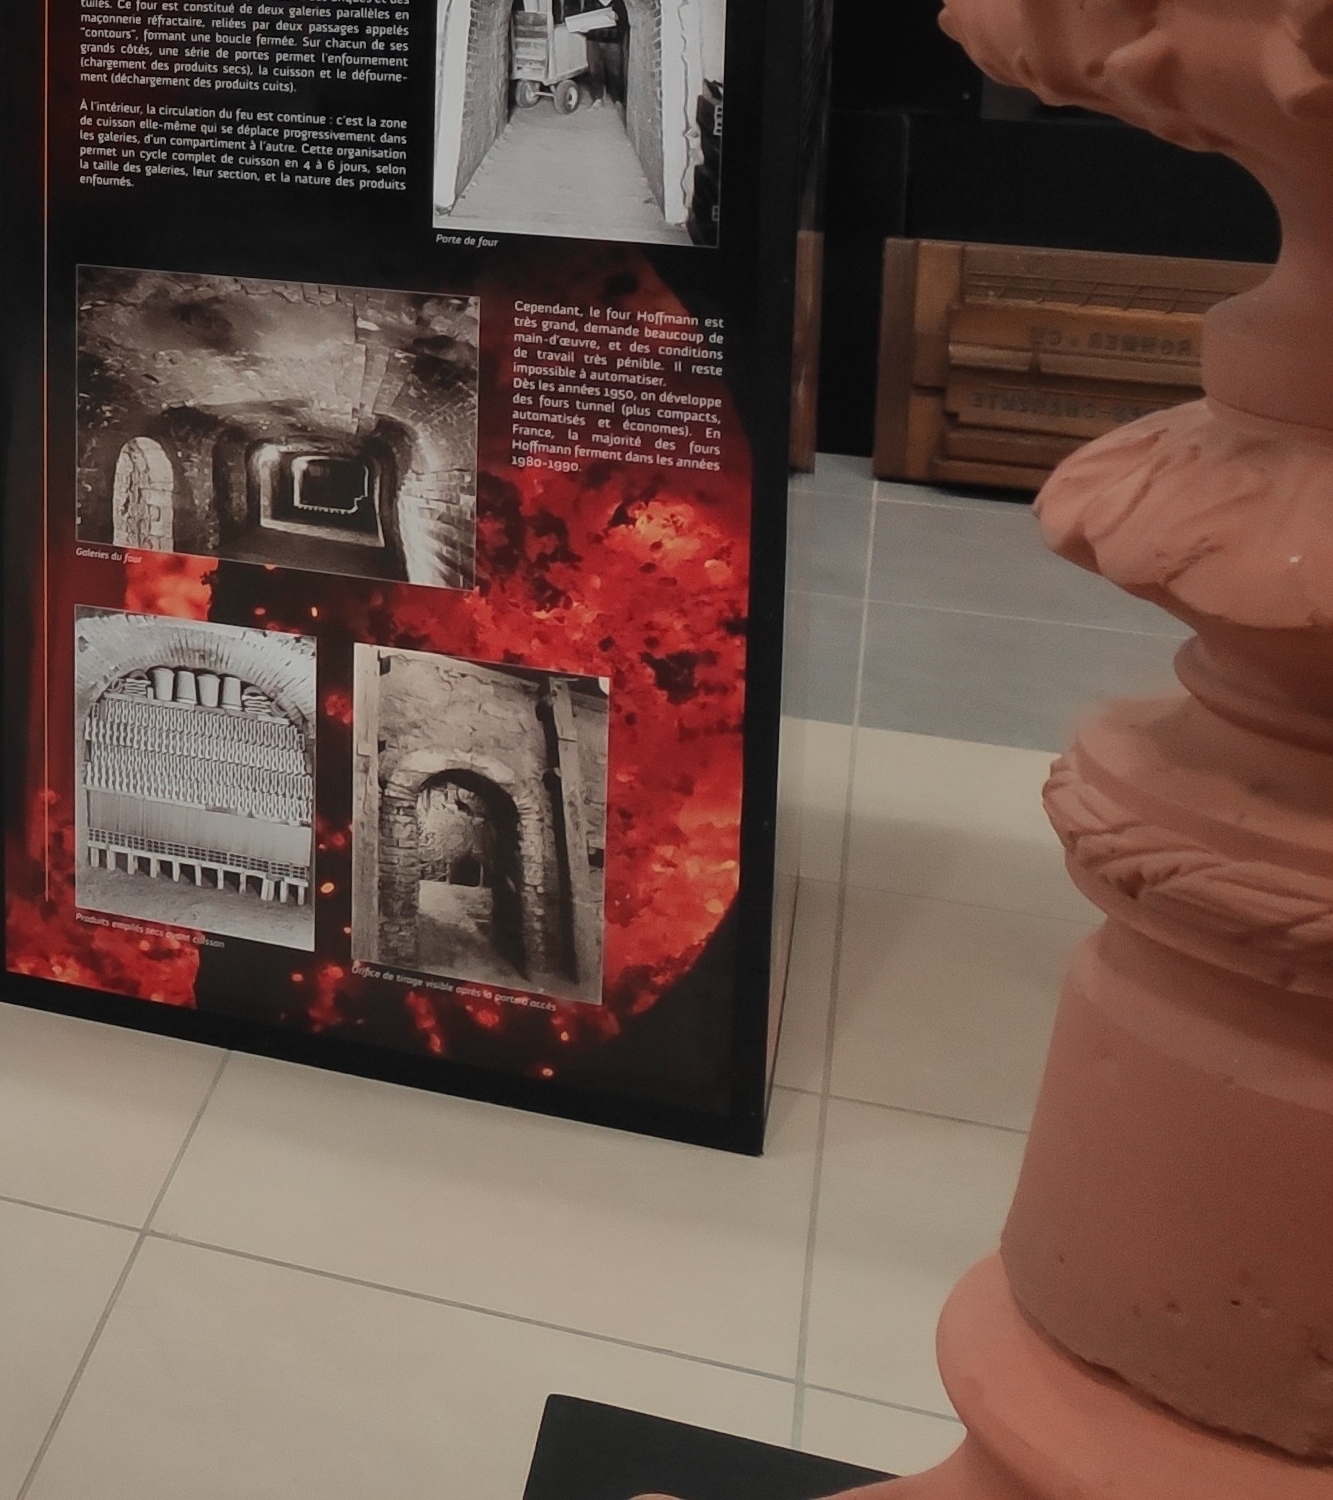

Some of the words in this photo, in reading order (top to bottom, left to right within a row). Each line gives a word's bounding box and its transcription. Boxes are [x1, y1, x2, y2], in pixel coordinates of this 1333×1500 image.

[116, 0, 131, 9] Ce
[135, 0, 156, 12] four
[161, 1, 178, 11] est
[183, 2, 234, 13] constitué
[239, 4, 252, 14] de
[257, 4, 284, 15] deux
[288, 6, 331, 17] galeries
[336, 8, 390, 19] parallèles
[394, 11, 409, 20] en
[80, 14, 141, 25] maçonnerie
[147, 15, 205, 28] réfractaire,
[211, 18, 246, 29] reliées
[252, 21, 270, 31] par
[275, 20, 302, 31] deux
[308, 23, 359, 35] passages
[365, 25, 409, 36] appelés
[79, 99, 88, 111] À
[146, 104, 156, 114] la
[158, 105, 216, 118] circulation
[218, 108, 232, 119] du
[235, 109, 253, 121] feu
[256, 111, 273, 121] est
[276, 113, 326, 124] continue
[366, 116, 376, 127] la
[379, 119, 407, 128] zone
[79, 115, 92, 126] de
[96, 117, 135, 128] cuisson
[139, 119, 196, 132] elle-même
[200, 123, 217, 134] qui
[220, 125, 233, 134] se
[236, 124, 279, 137] déplace
[283, 129, 375, 142] progressivement
[379, 133, 407, 144] dans
[435, 233, 462, 244] Porte
[463, 235, 476, 245] de
[477, 236, 498, 247] four
[589, 307, 600, 318] le
[606, 308, 630, 321] four
[636, 311, 698, 326] Hoffmann
[704, 318, 724, 328] est
[513, 317, 537, 328] très
[583, 322, 639, 337] demande
[644, 327, 704, 344] beaucoup
[708, 333, 724, 344] de
[608, 340, 621, 351] et
[628, 342, 650, 353] des
[658, 346, 723, 359] conditions
[513, 347, 527, 358] de
[536, 349, 574, 362] travail
[583, 353, 607, 365] très
[673, 361, 681, 372] Il
[691, 365, 722, 375] reste
[75, 547, 109, 559] Galeries
[110, 551, 122, 561] du
[75, 912, 110, 927] Produits
[145, 927, 163, 937] secs
[382, 970, 394, 981] de
